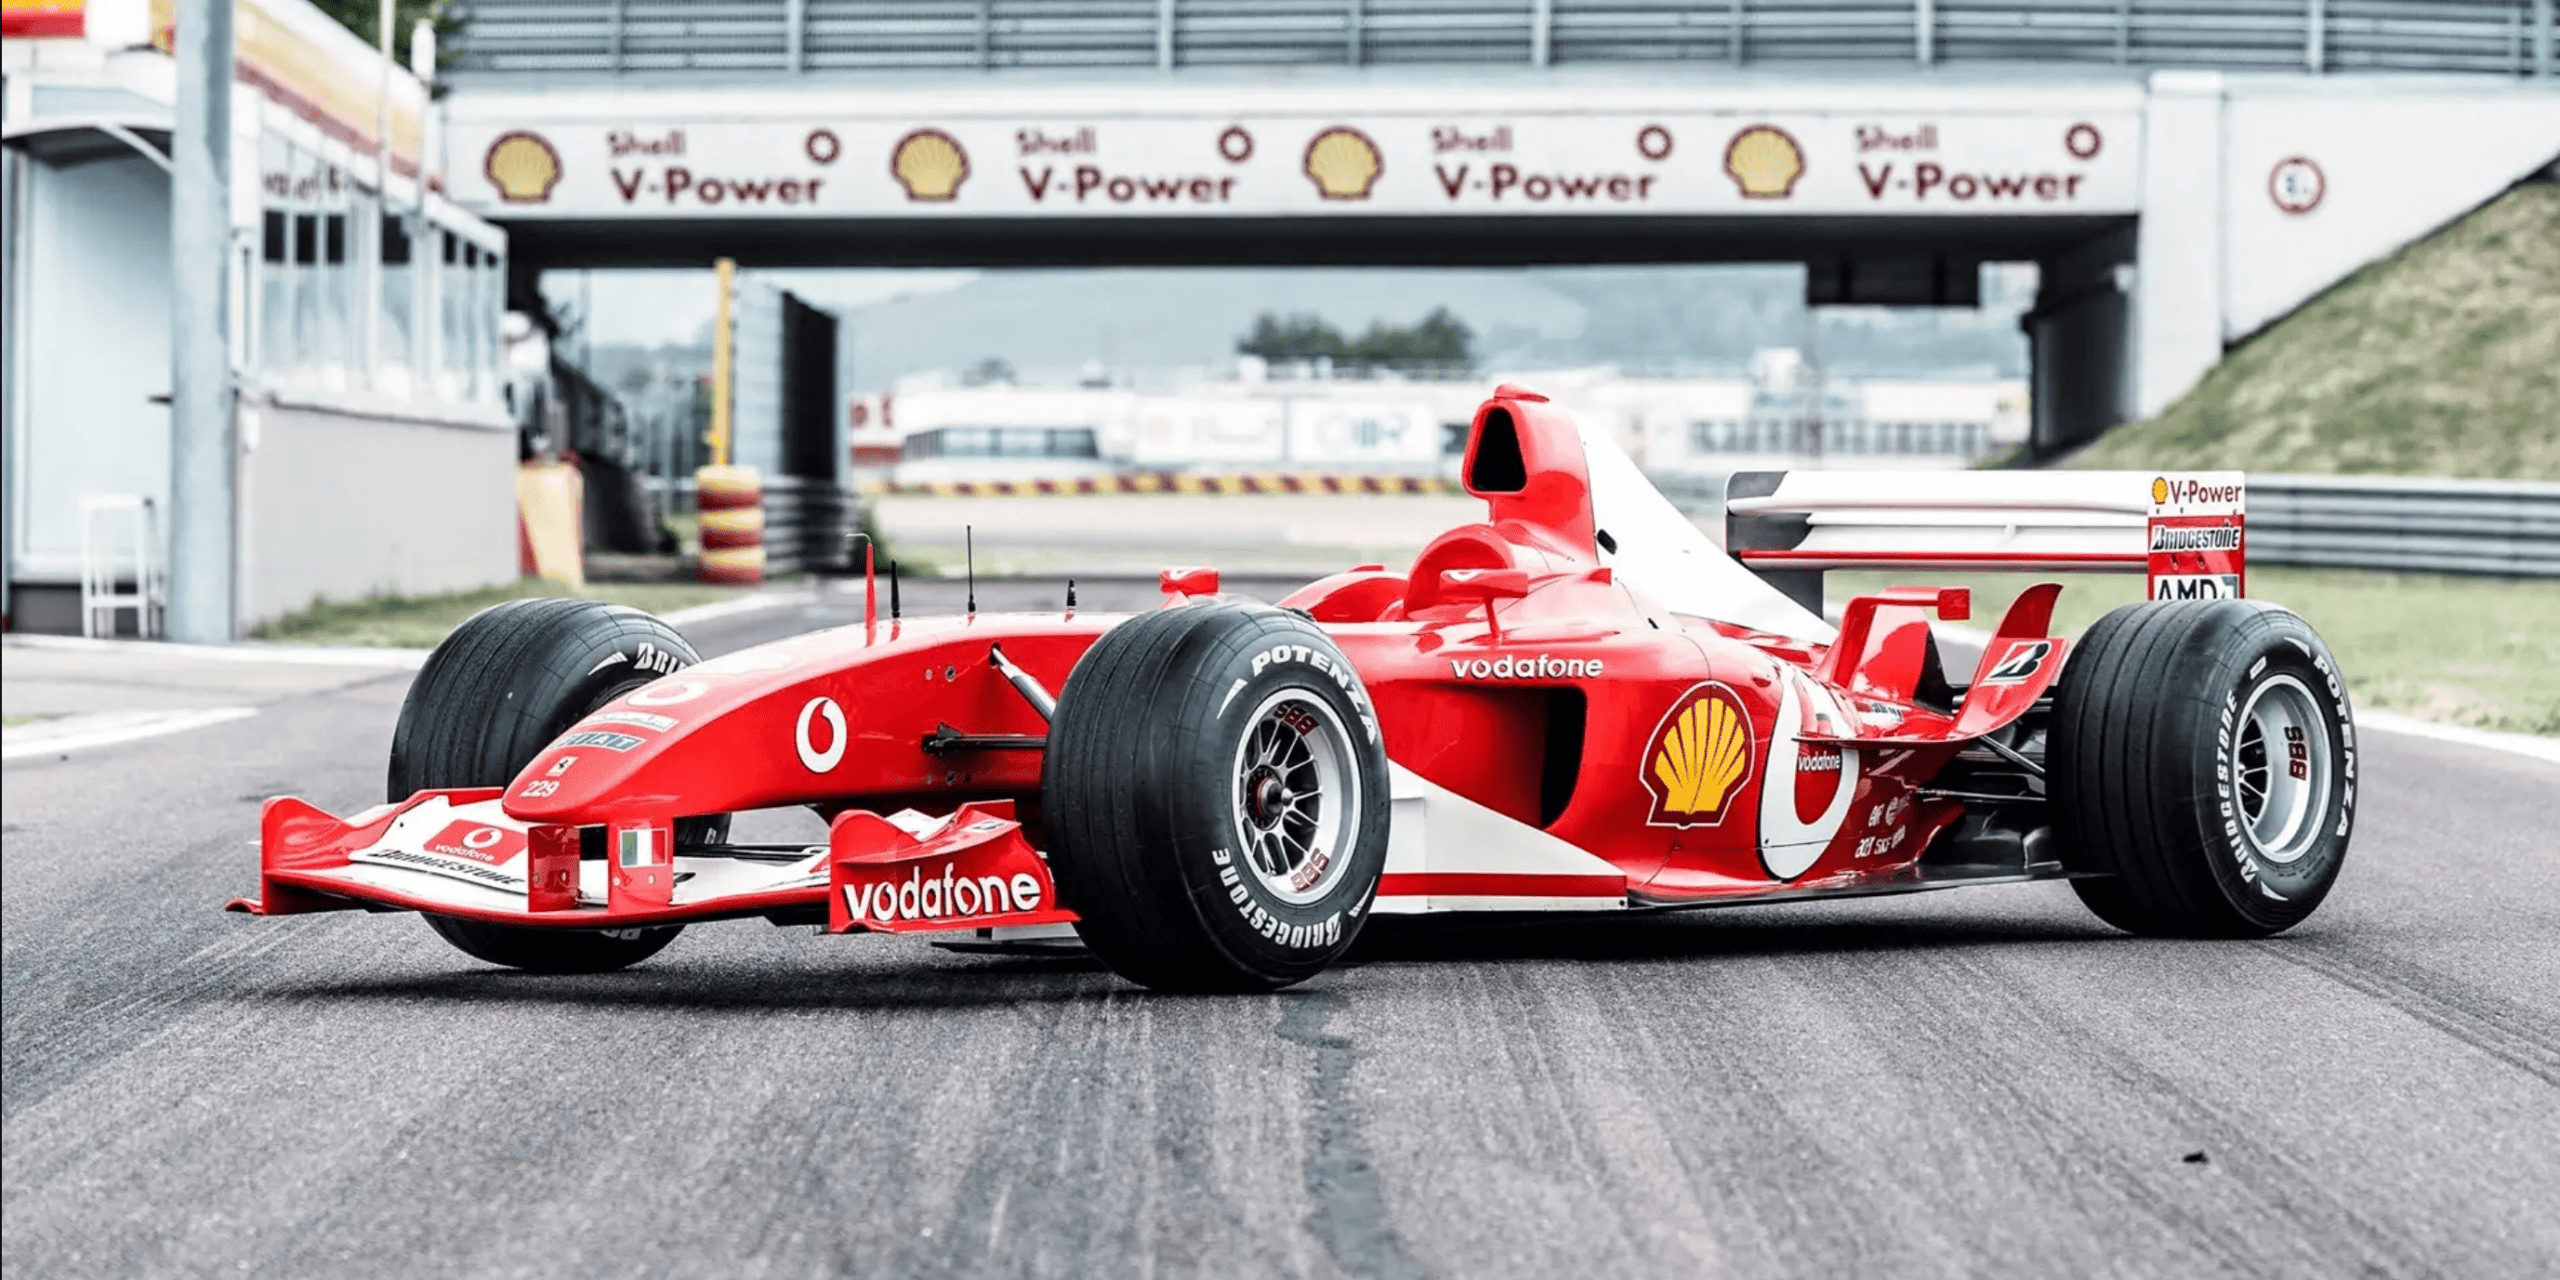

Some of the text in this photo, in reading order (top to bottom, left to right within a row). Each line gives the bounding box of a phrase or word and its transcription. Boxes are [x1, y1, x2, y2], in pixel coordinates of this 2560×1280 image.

[607, 130, 686, 156] Shell
[1017, 127, 1096, 156] Shell
[1432, 126, 1513, 154] Shell
[1856, 125, 1938, 153] Shell
[611, 167, 824, 204] V-Power
[1020, 165, 1236, 203] V-Power
[1435, 163, 1655, 201] V-Power
[1858, 163, 2084, 200] V-Power
[2170, 480, 2241, 504] V-Power
[2152, 527, 2240, 551] BRIDGESTONE
[2158, 578, 2218, 600] AMD
[634, 642, 688, 676] BRI
[1451, 654, 1603, 678] vodafone
[1251, 645, 1376, 744] POTENZA
[1799, 750, 1840, 770] vodafone
[2284, 726, 2307, 781] BBS
[2313, 654, 2354, 836] POTENZA
[520, 780, 560, 797] 229
[2217, 689, 2259, 882] BRIDGESTONE
[435, 844, 495, 862] vodafone
[1290, 848, 1330, 891] BBS
[844, 863, 1041, 921] vodafone
[1212, 848, 1341, 948] BRIDGESTONE
